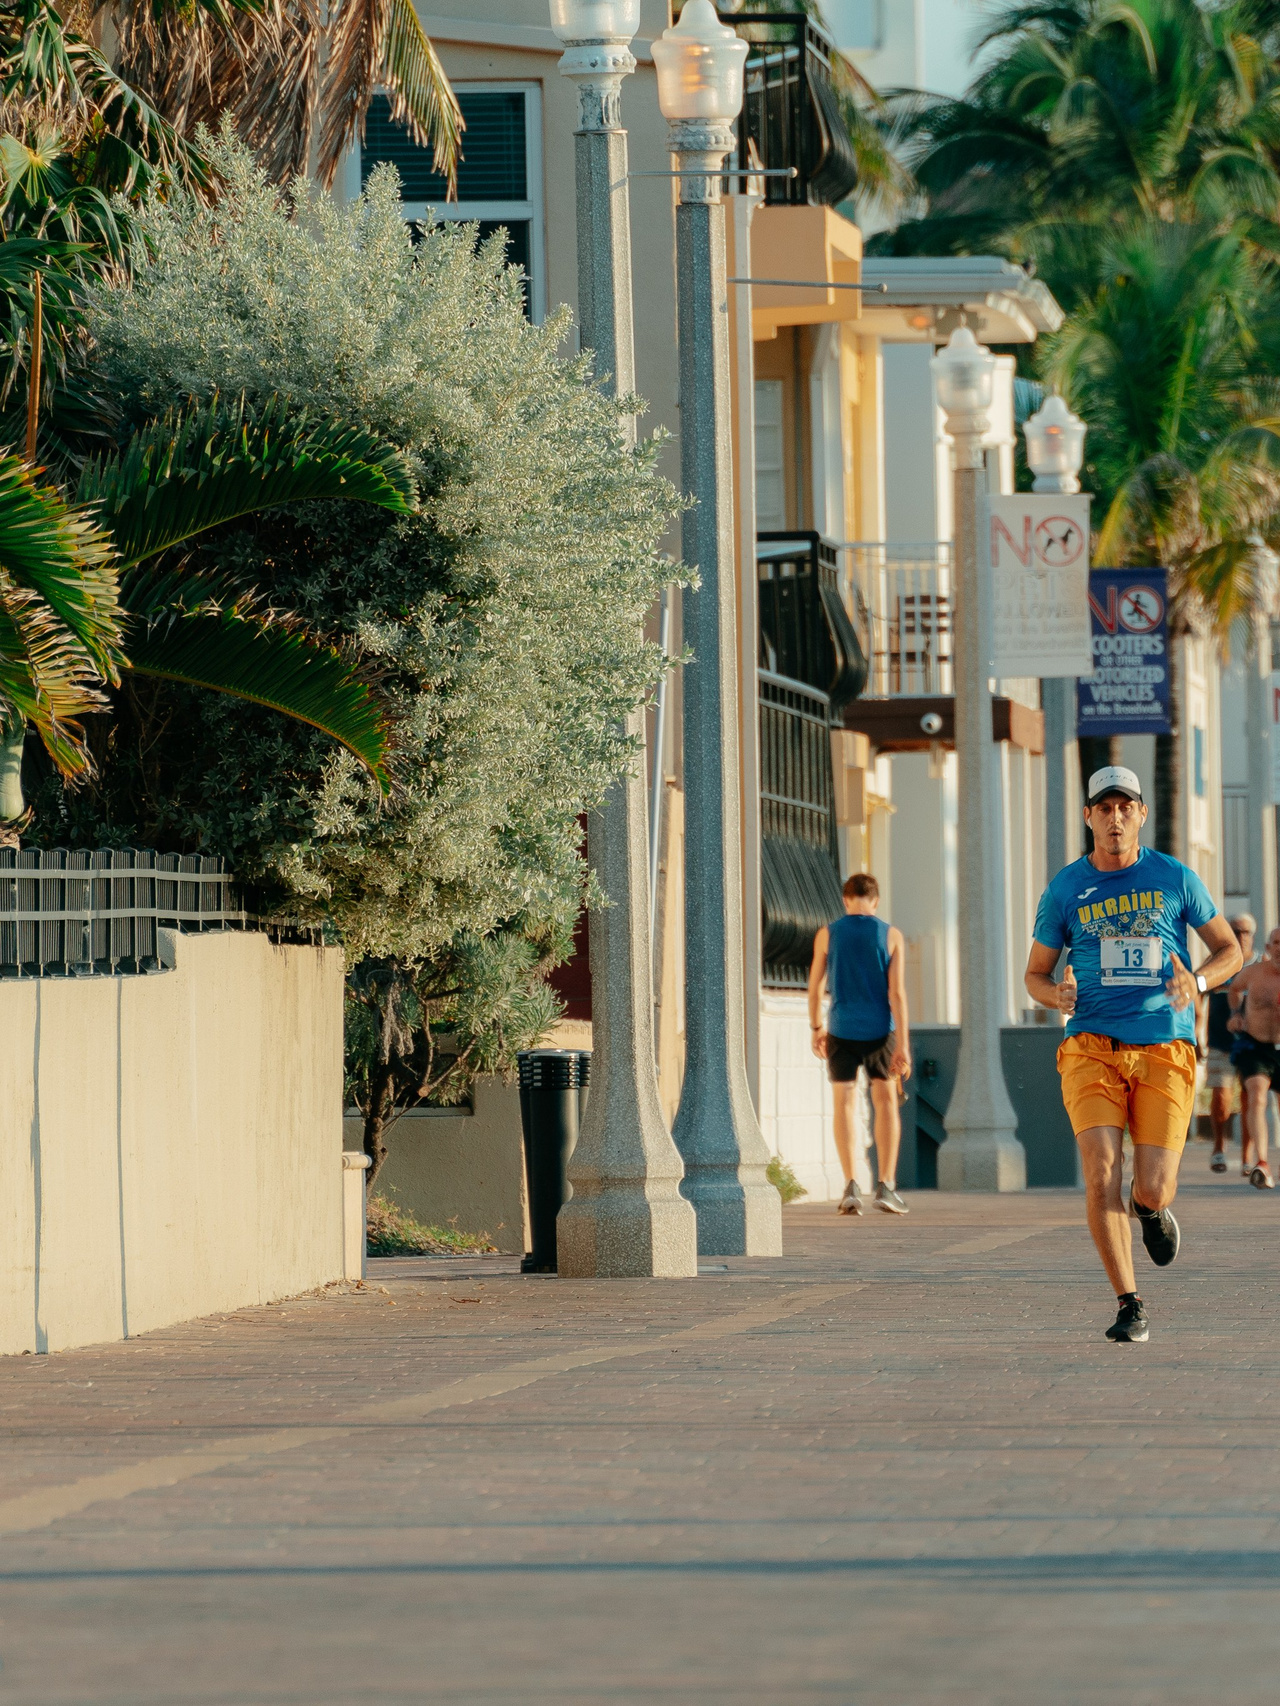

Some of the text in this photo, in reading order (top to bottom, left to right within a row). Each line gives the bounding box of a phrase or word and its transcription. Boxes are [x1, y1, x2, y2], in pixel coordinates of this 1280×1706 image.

[1092, 633, 1165, 655] COOTERS
[1090, 685, 1155, 702] VEHICLES
[1078, 889, 1164, 925] UKRAINE
[1122, 948, 1143, 967] 13
